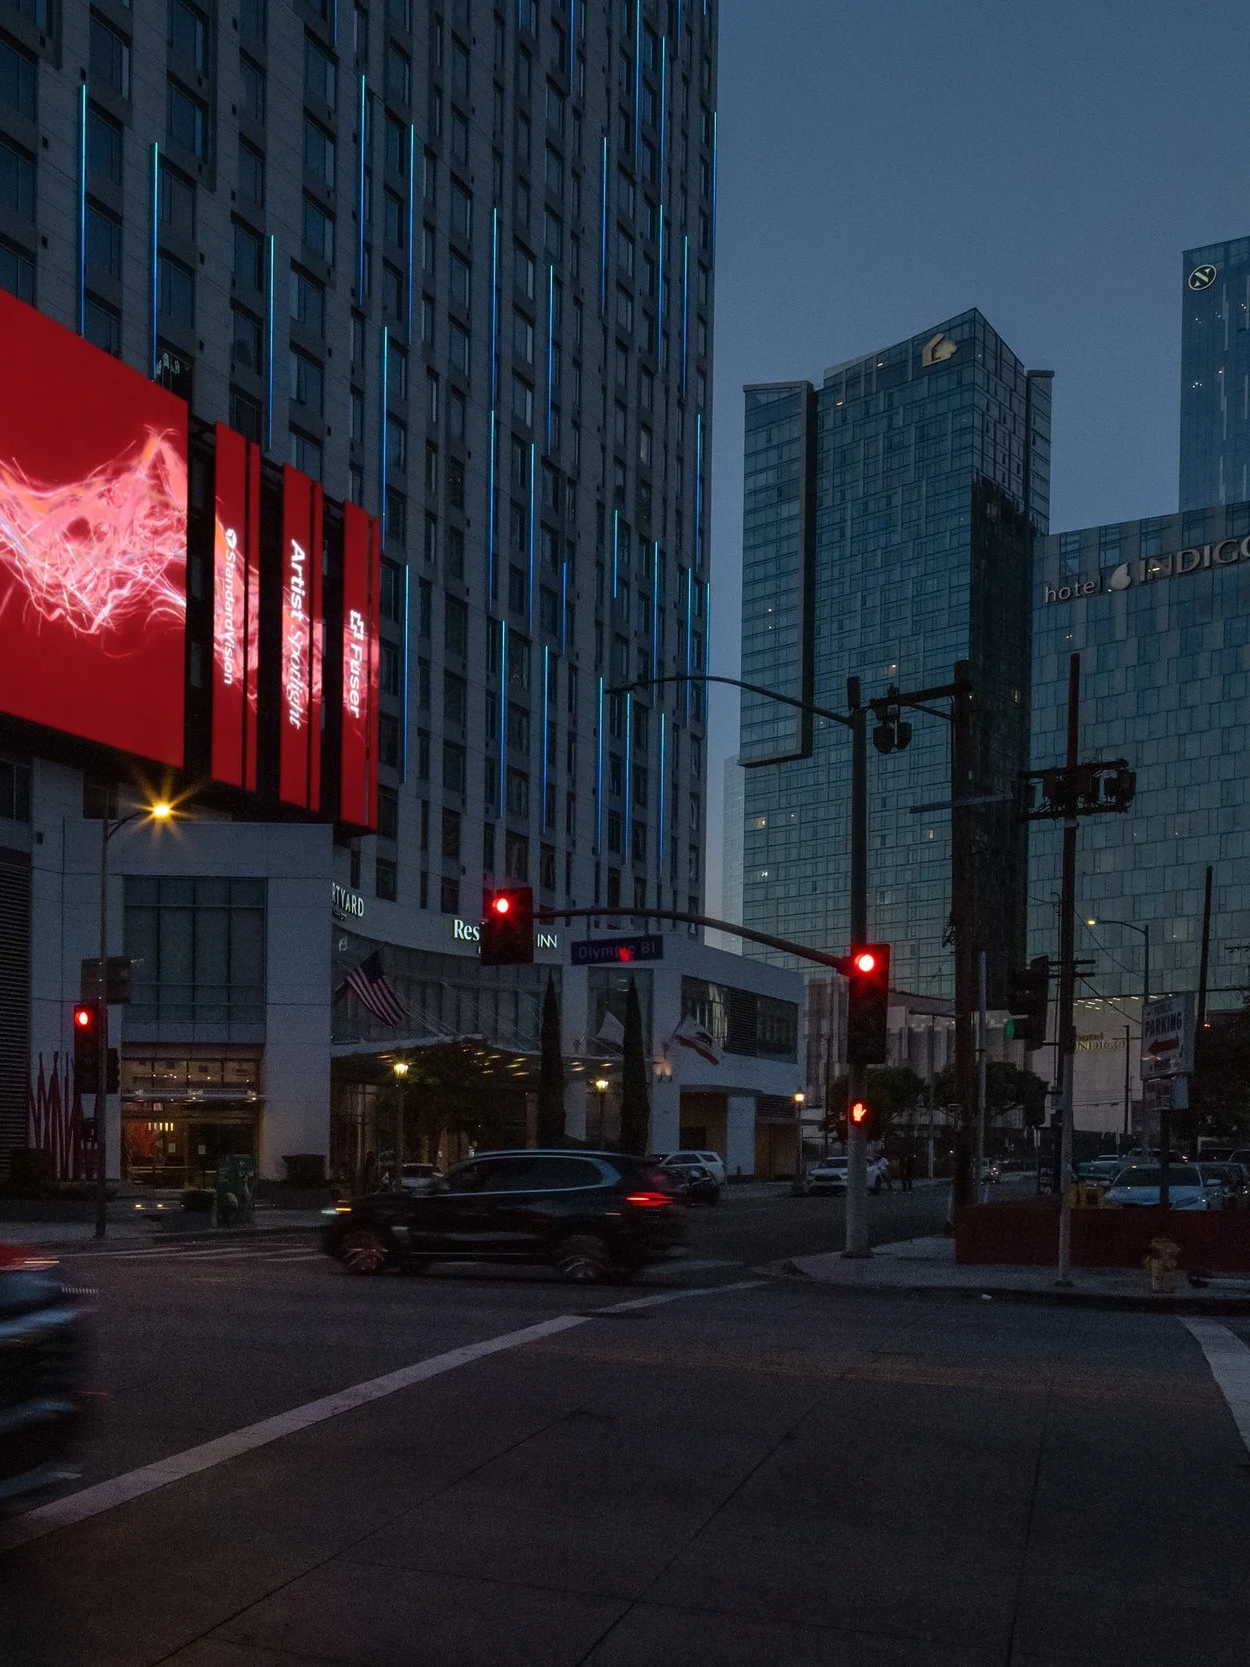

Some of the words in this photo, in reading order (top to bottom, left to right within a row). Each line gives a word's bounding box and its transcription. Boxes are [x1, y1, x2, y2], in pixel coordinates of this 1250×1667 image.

[223, 549, 237, 685] StandardVision
[290, 538, 306, 621] Artist
[287, 623, 306, 730] Spotlight
[350, 643, 363, 718] Fuser
[537, 933, 557, 949] INN
[1145, 1011, 1182, 1038] PARKING
